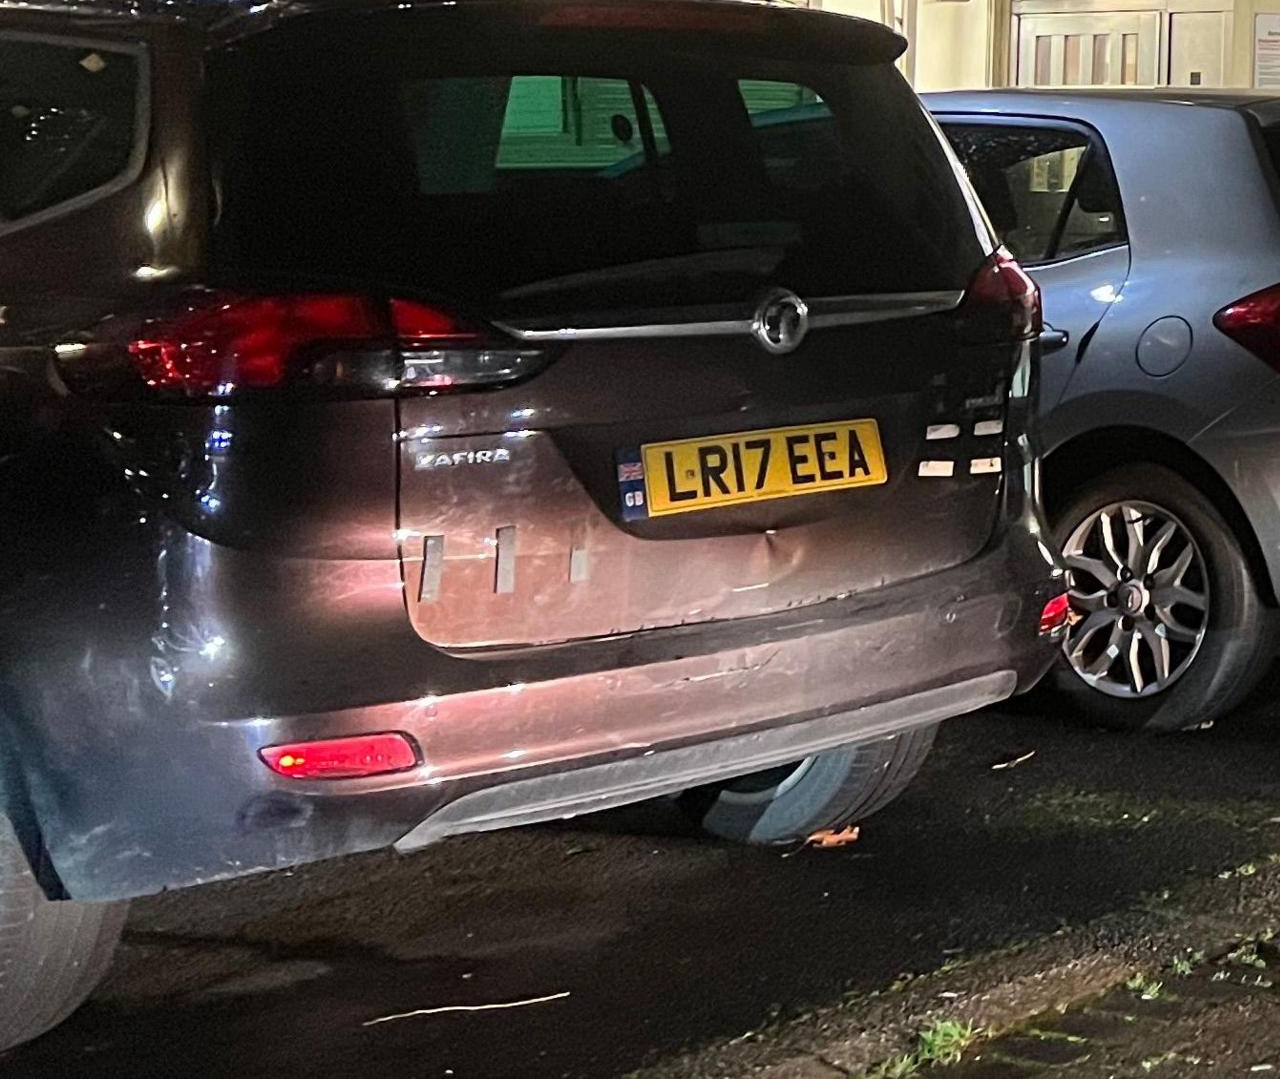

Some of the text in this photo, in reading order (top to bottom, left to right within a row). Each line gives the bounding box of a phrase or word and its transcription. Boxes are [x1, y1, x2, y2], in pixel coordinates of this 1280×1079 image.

[664, 429, 871, 502] LR17 EEA
[624, 491, 644, 508] GB
